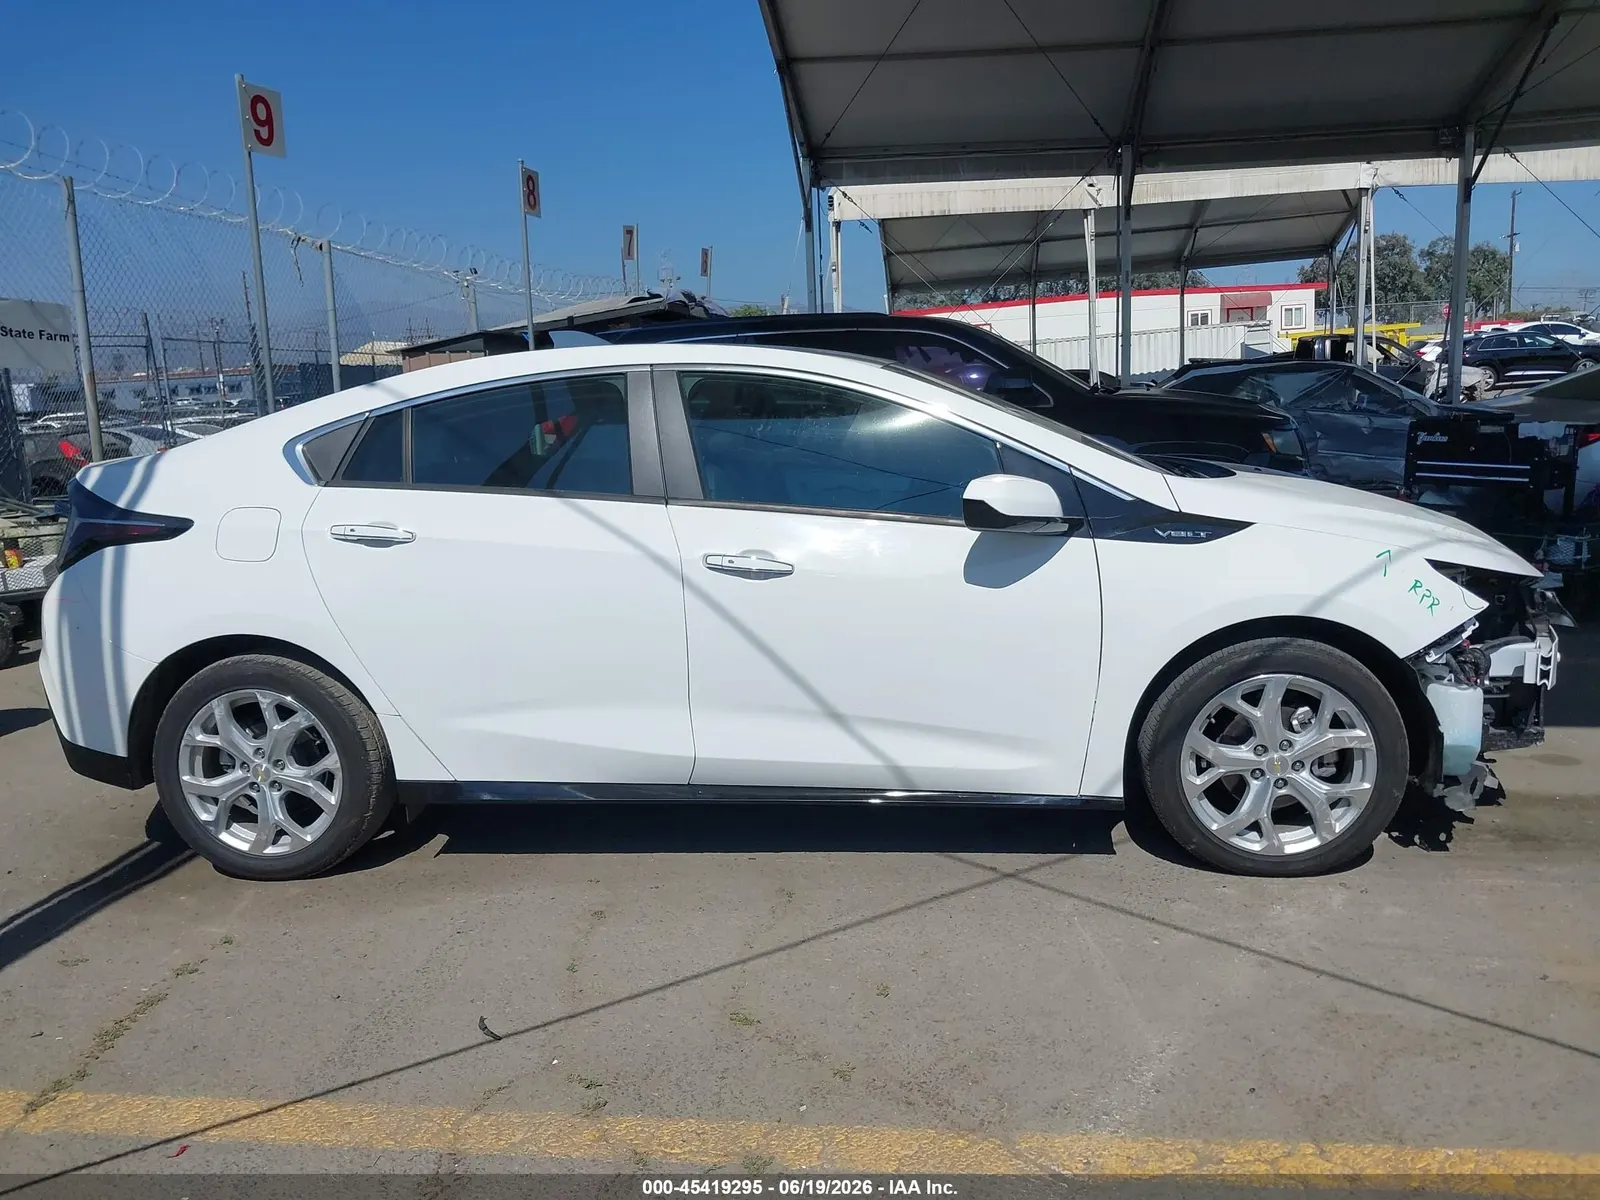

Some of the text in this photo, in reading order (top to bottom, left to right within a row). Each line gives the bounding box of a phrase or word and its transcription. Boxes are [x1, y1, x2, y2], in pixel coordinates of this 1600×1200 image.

[250, 94, 274, 147] 9
[526, 174, 536, 211] 8
[625, 229, 634, 256] 7
[0, 325, 70, 343] State Farm
[1153, 527, 1212, 539] VOLT
[1408, 579, 1440, 617] RPR
